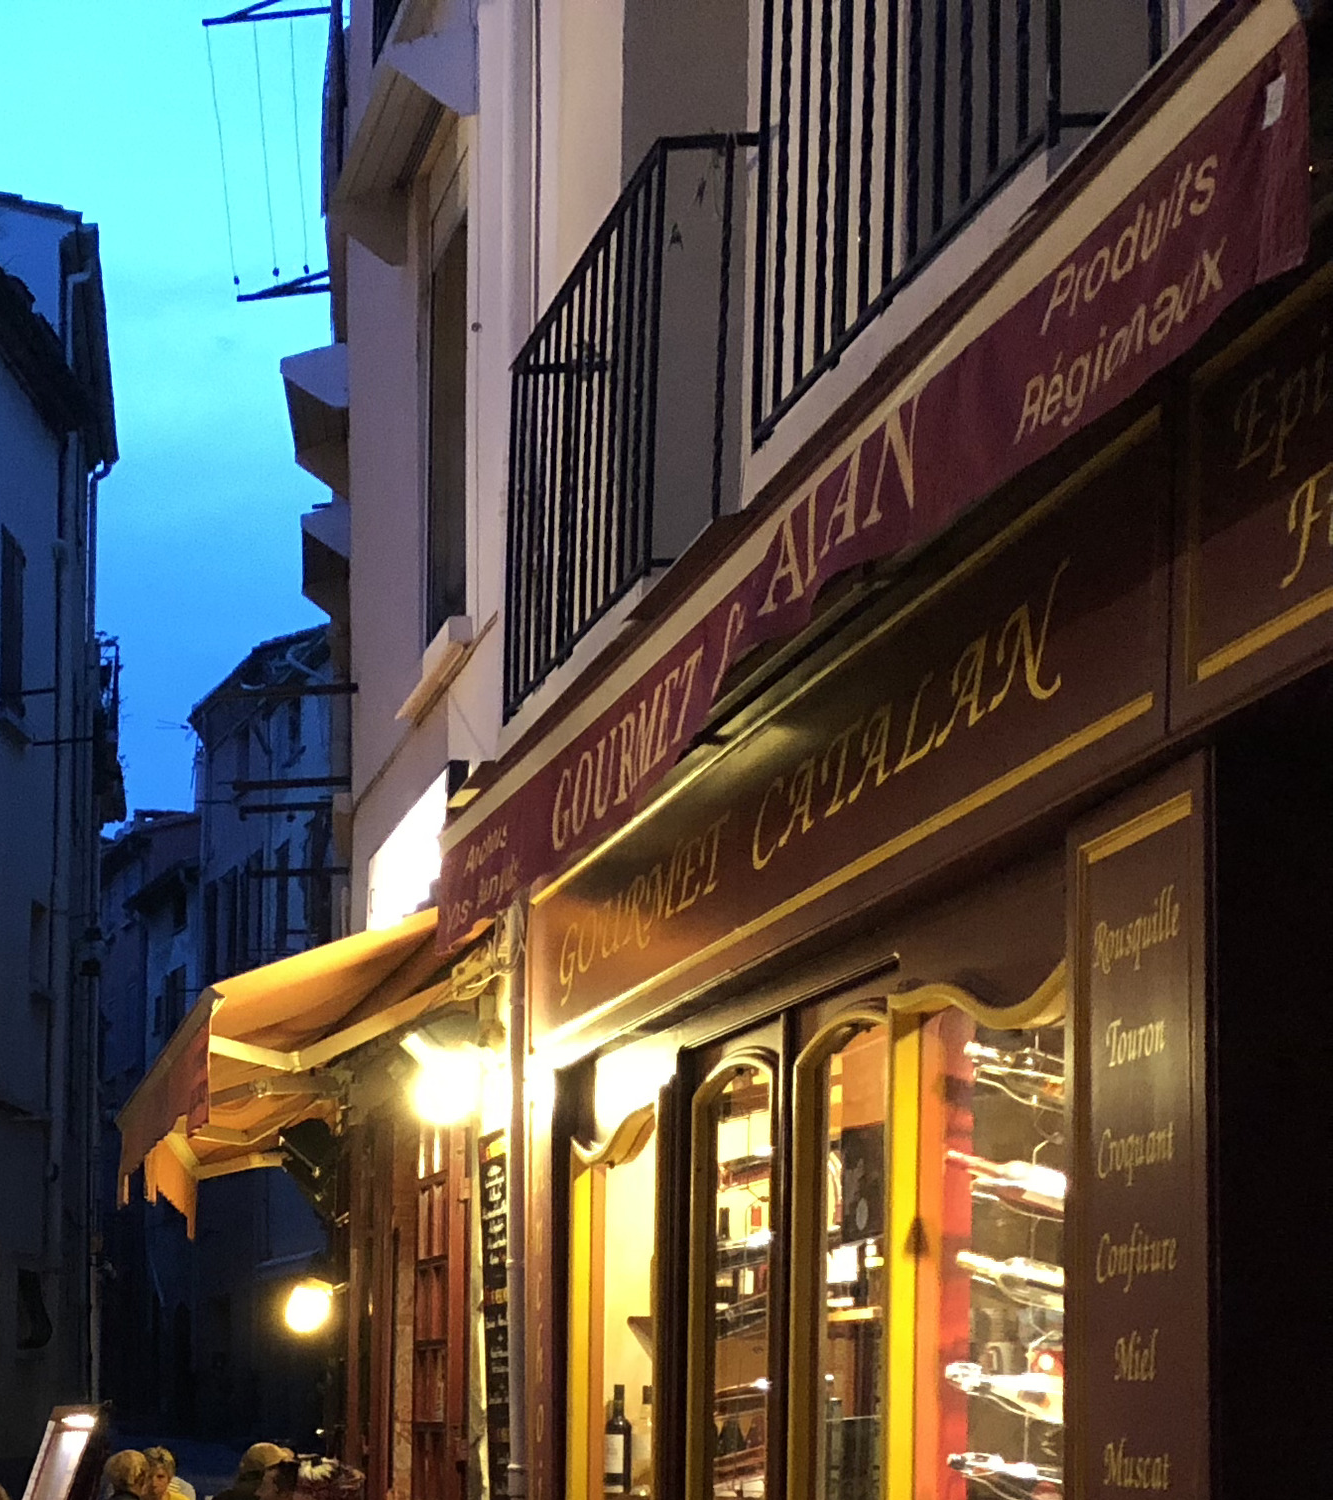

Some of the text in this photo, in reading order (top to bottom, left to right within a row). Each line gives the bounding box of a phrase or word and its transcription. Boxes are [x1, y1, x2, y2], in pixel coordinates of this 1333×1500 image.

[1039, 153, 1219, 335] Produits
[1014, 236, 1228, 443] Régionaux
[551, 643, 704, 851] GOURMET
[558, 556, 1070, 1007] GOURMET CATALAN
[1093, 883, 1180, 974] Rousquille
[1105, 1017, 1166, 1068] Touron
[1097, 1121, 1175, 1187] Croquant
[1096, 1221, 1177, 1295] Confiture
[1114, 1328, 1159, 1382] Miel
[1103, 1437, 1171, 1491] Muscat
